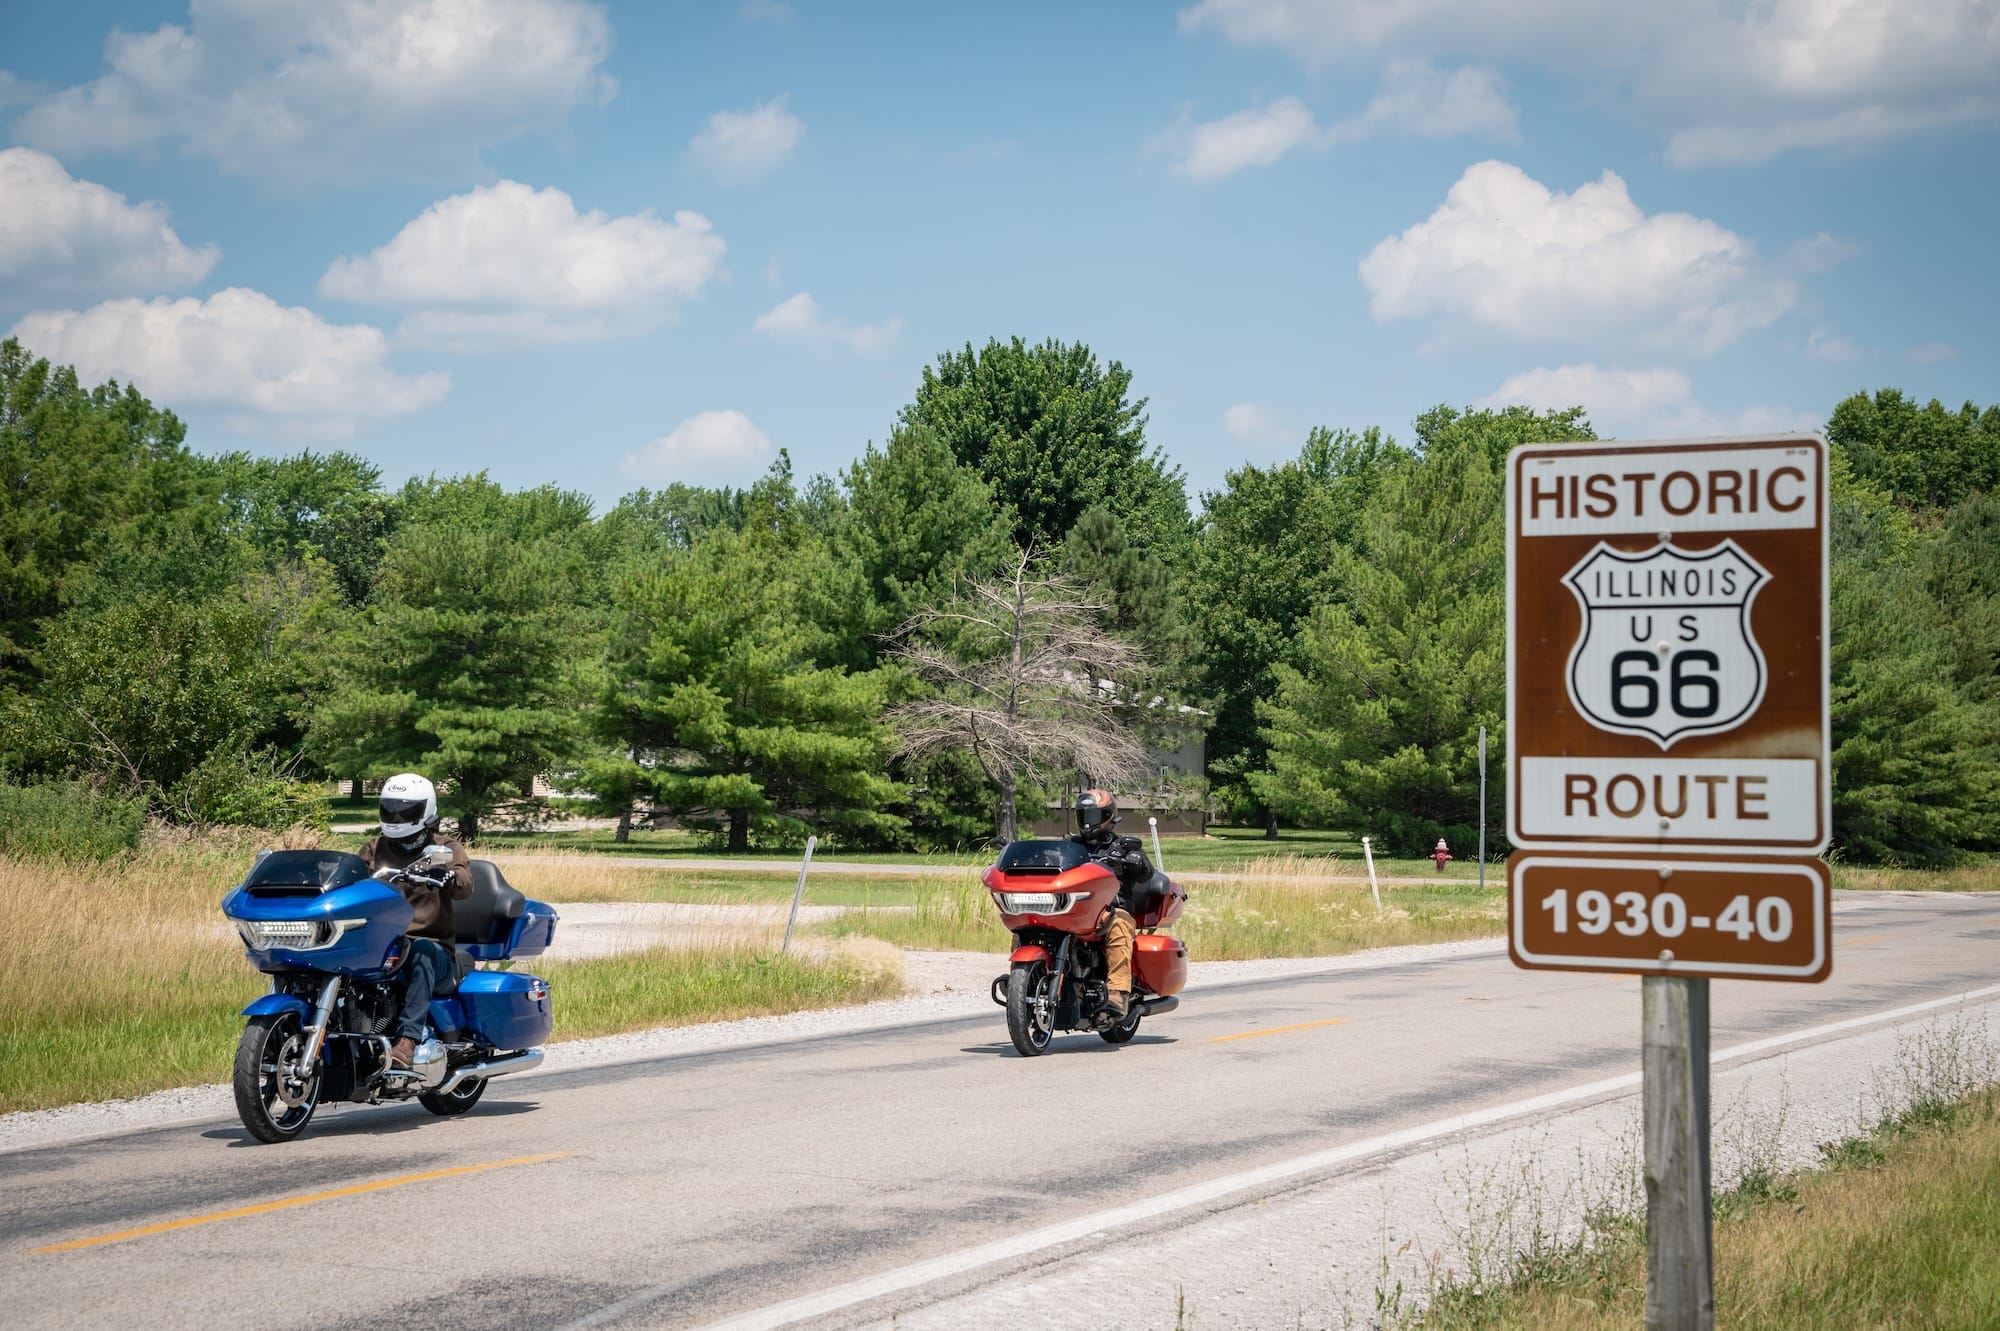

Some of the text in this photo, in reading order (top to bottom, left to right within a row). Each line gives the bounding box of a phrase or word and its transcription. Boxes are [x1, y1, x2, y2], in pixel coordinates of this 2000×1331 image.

[1529, 466, 1807, 520] HISTORIC
[1596, 568, 1738, 598] ILLINOIS
[1610, 650, 1720, 719] 66
[1564, 773, 1769, 821] ROUTE
[1541, 888, 1793, 942] 1930-40
